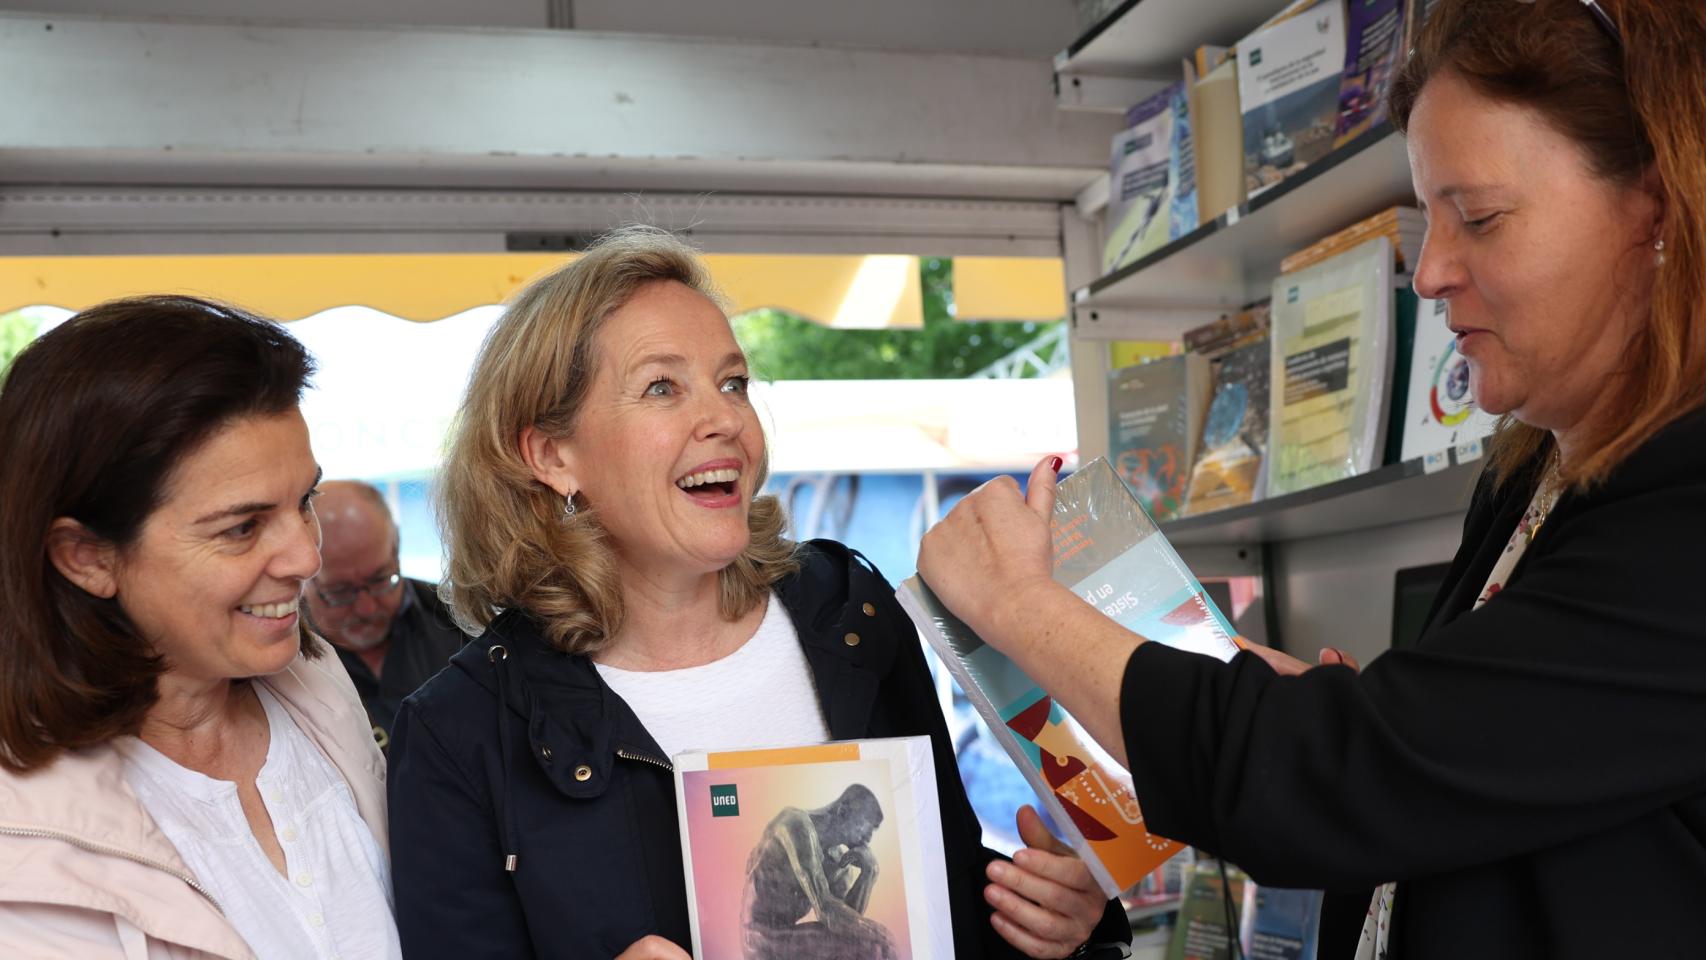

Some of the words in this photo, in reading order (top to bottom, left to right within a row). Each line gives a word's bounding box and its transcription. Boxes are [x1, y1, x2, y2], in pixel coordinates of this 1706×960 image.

[1096, 584, 1113, 600] en
[1102, 591, 1138, 617] Siste
[713, 795, 736, 806] UNED
